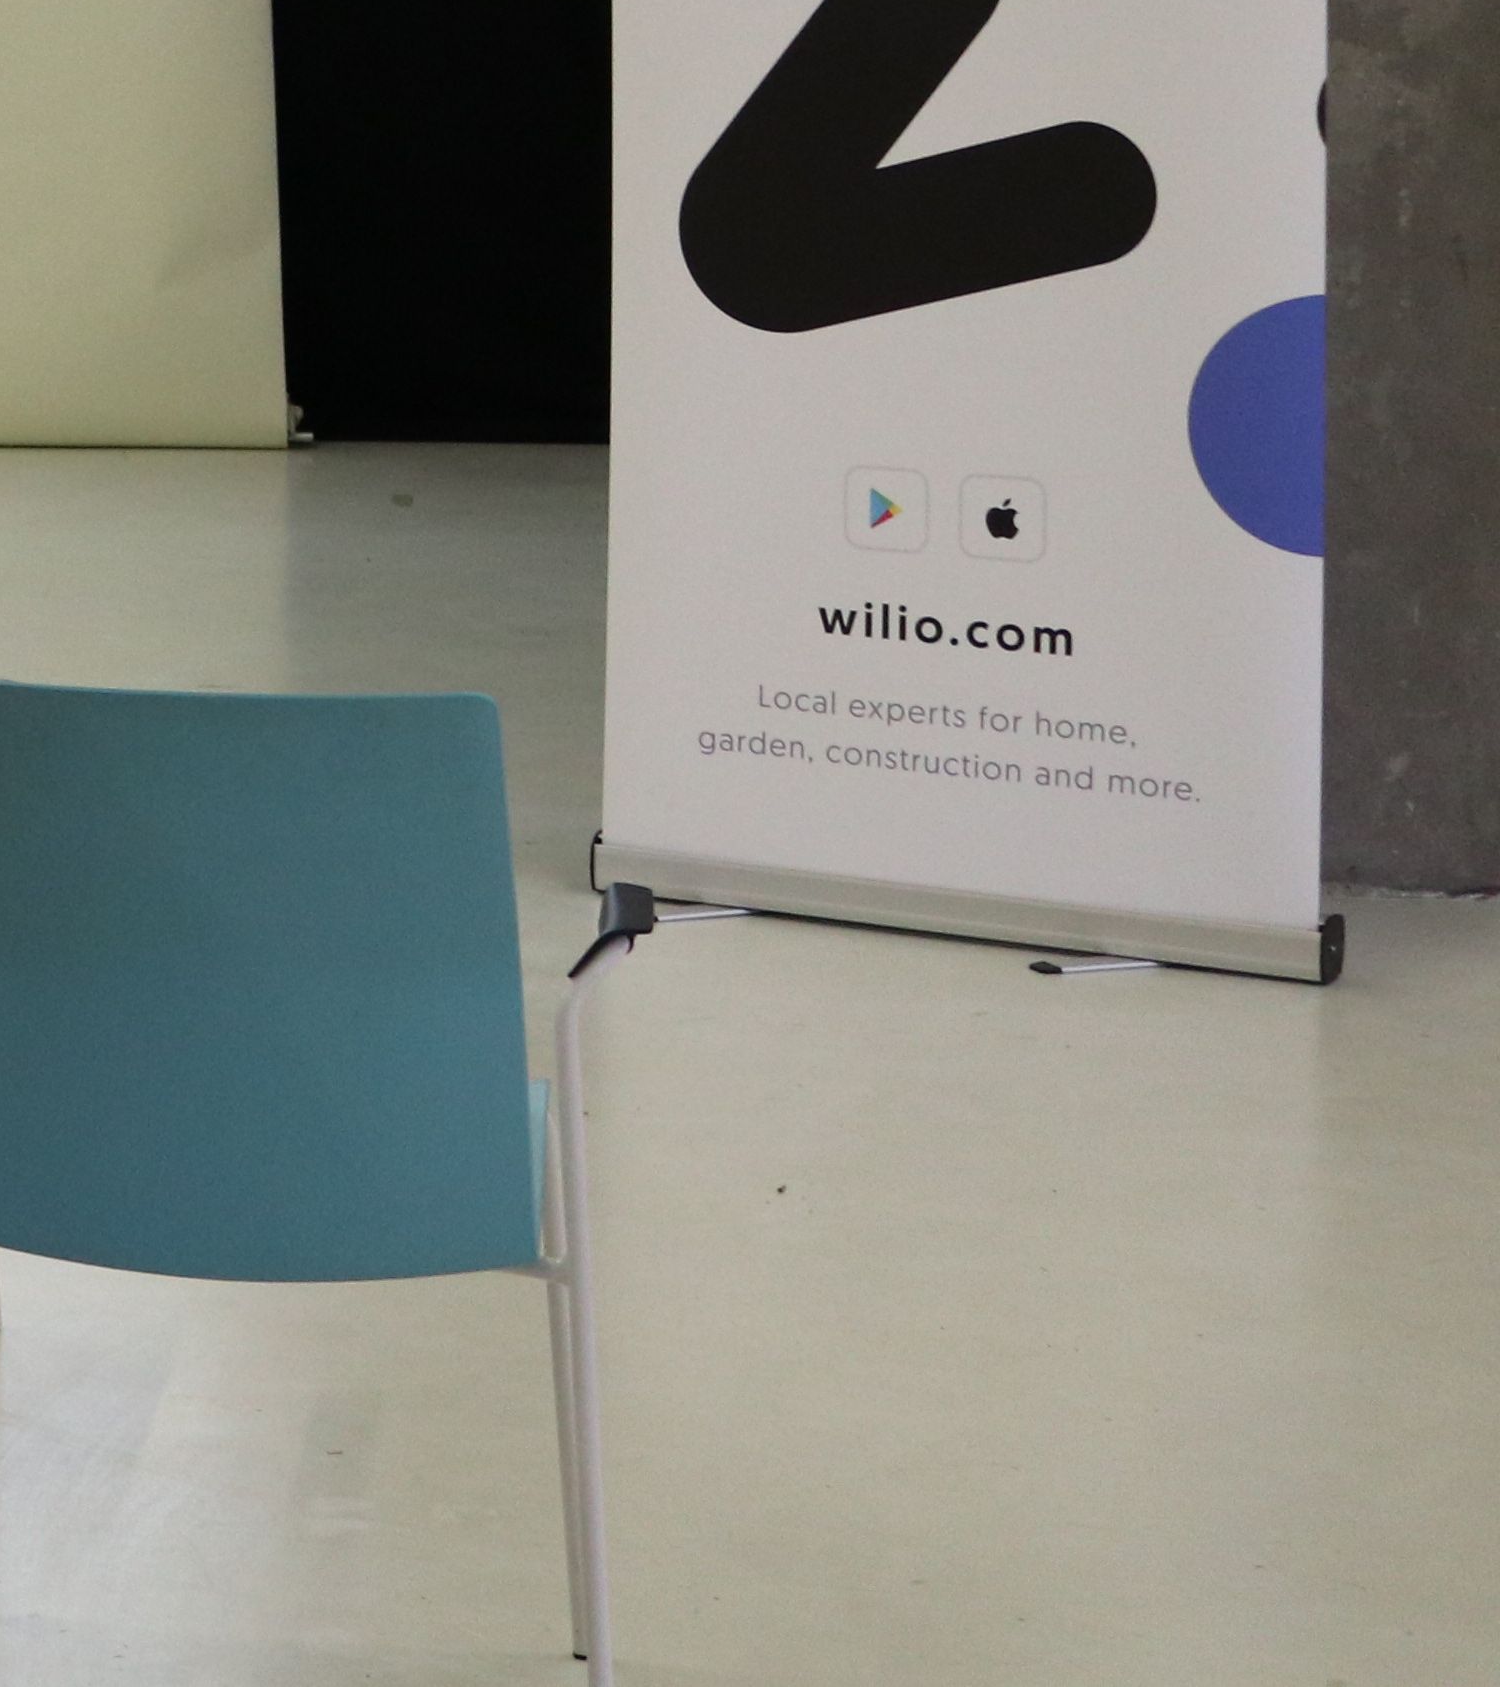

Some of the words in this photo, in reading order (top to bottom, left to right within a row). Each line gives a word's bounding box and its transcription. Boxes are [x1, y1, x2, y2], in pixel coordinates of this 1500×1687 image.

[818, 601, 1074, 657] wilio.com
[757, 684, 837, 717] Local
[848, 698, 967, 726] experts
[979, 705, 1023, 734] for
[1035, 711, 1138, 749] home,
[697, 729, 815, 765] garden,
[826, 743, 1022, 784] construction
[1035, 762, 1094, 792] and
[1107, 771, 1201, 804] more.
